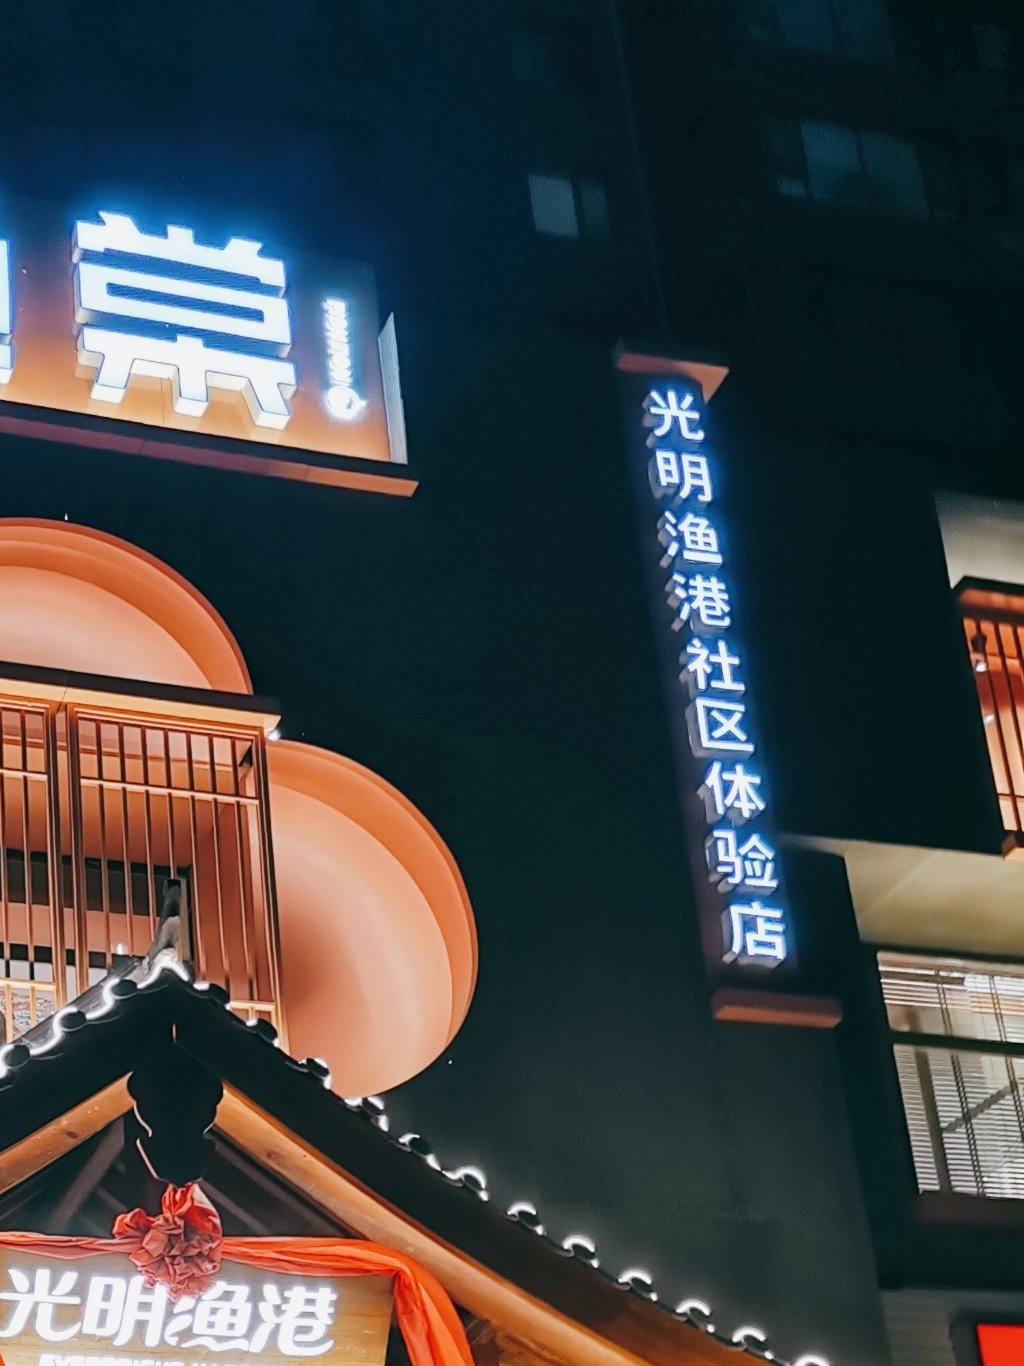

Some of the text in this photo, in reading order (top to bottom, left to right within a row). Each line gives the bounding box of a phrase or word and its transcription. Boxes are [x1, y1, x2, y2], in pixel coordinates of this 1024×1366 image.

[644, 386, 788, 966] 光明渔港社区体验店
